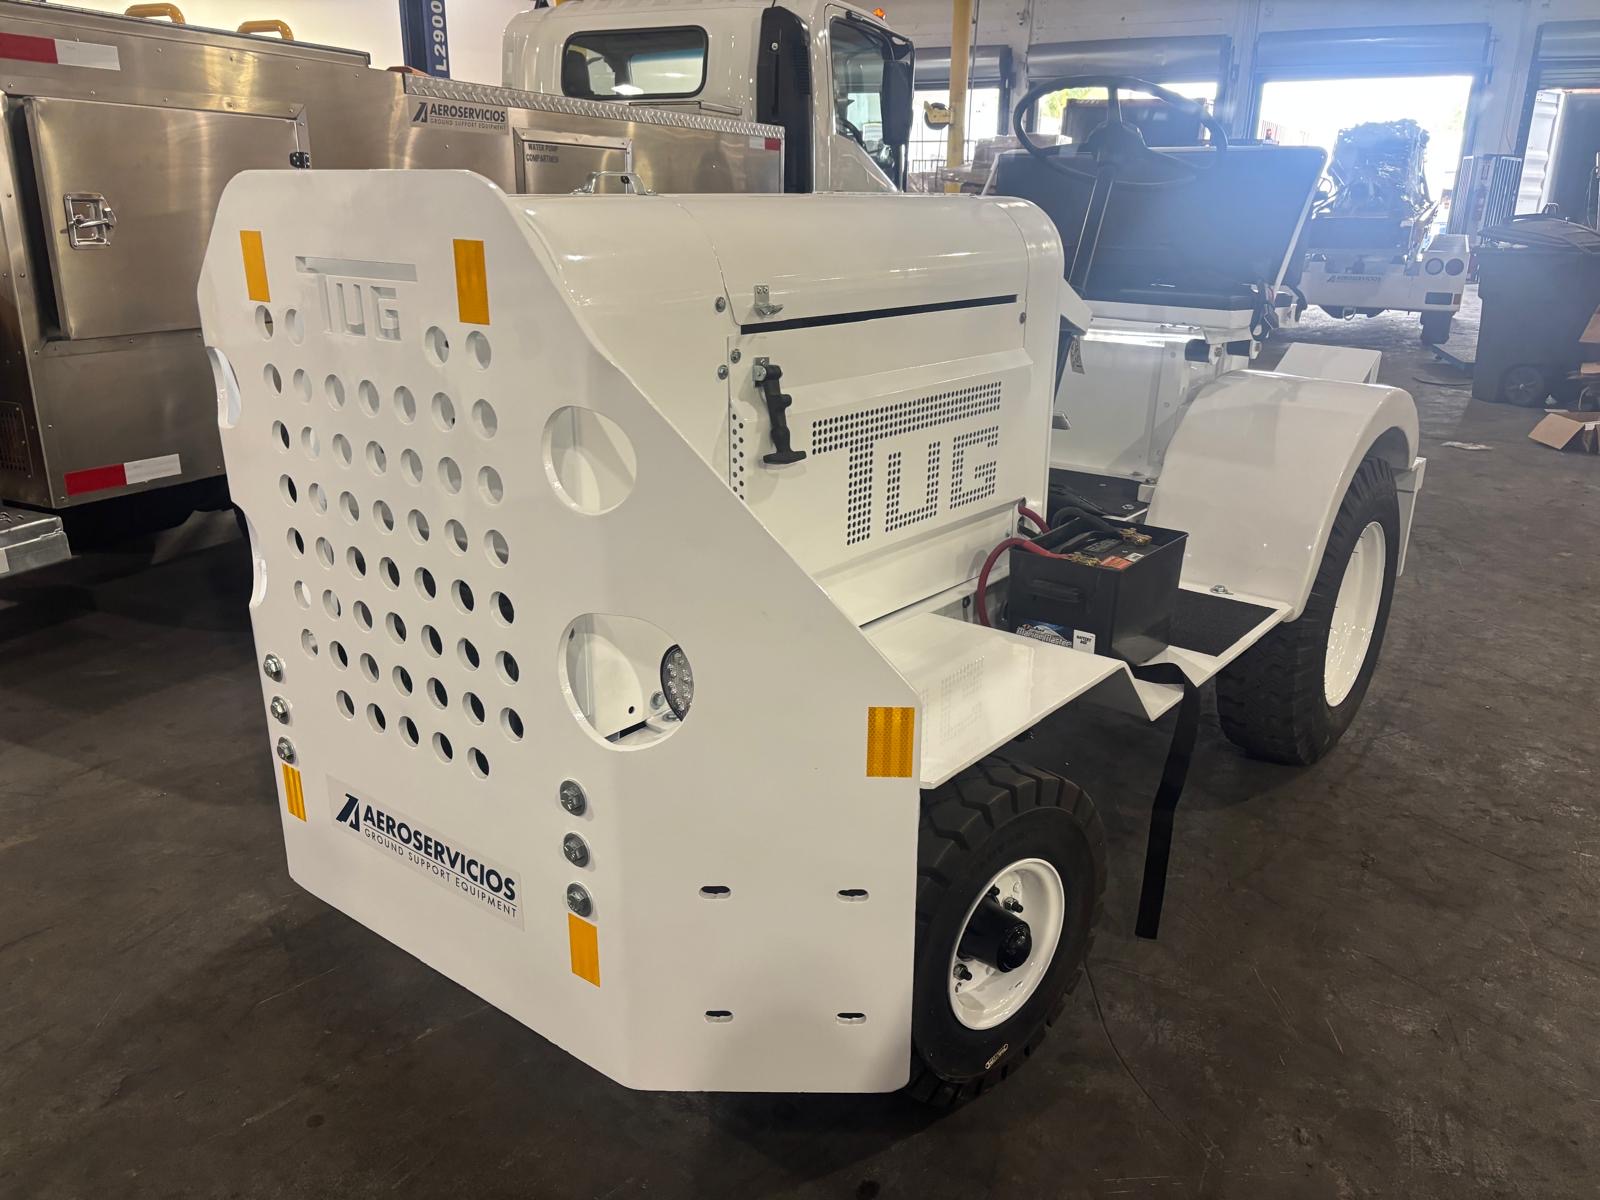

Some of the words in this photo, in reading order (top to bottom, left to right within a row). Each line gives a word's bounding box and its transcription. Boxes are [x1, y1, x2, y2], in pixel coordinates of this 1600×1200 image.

[430, 103, 506, 122] AEROSERVICIOS
[431, 118, 453, 126] GROUND
[479, 123, 506, 131] EQUIPMENT
[294, 255, 418, 341] TUG
[812, 380, 1001, 545] TUG
[363, 804, 516, 901] AEROSERVICIOS
[364, 827, 404, 857] GROUND
[408, 851, 451, 883] SUPPORT
[455, 877, 517, 918] EQUIPMENT
